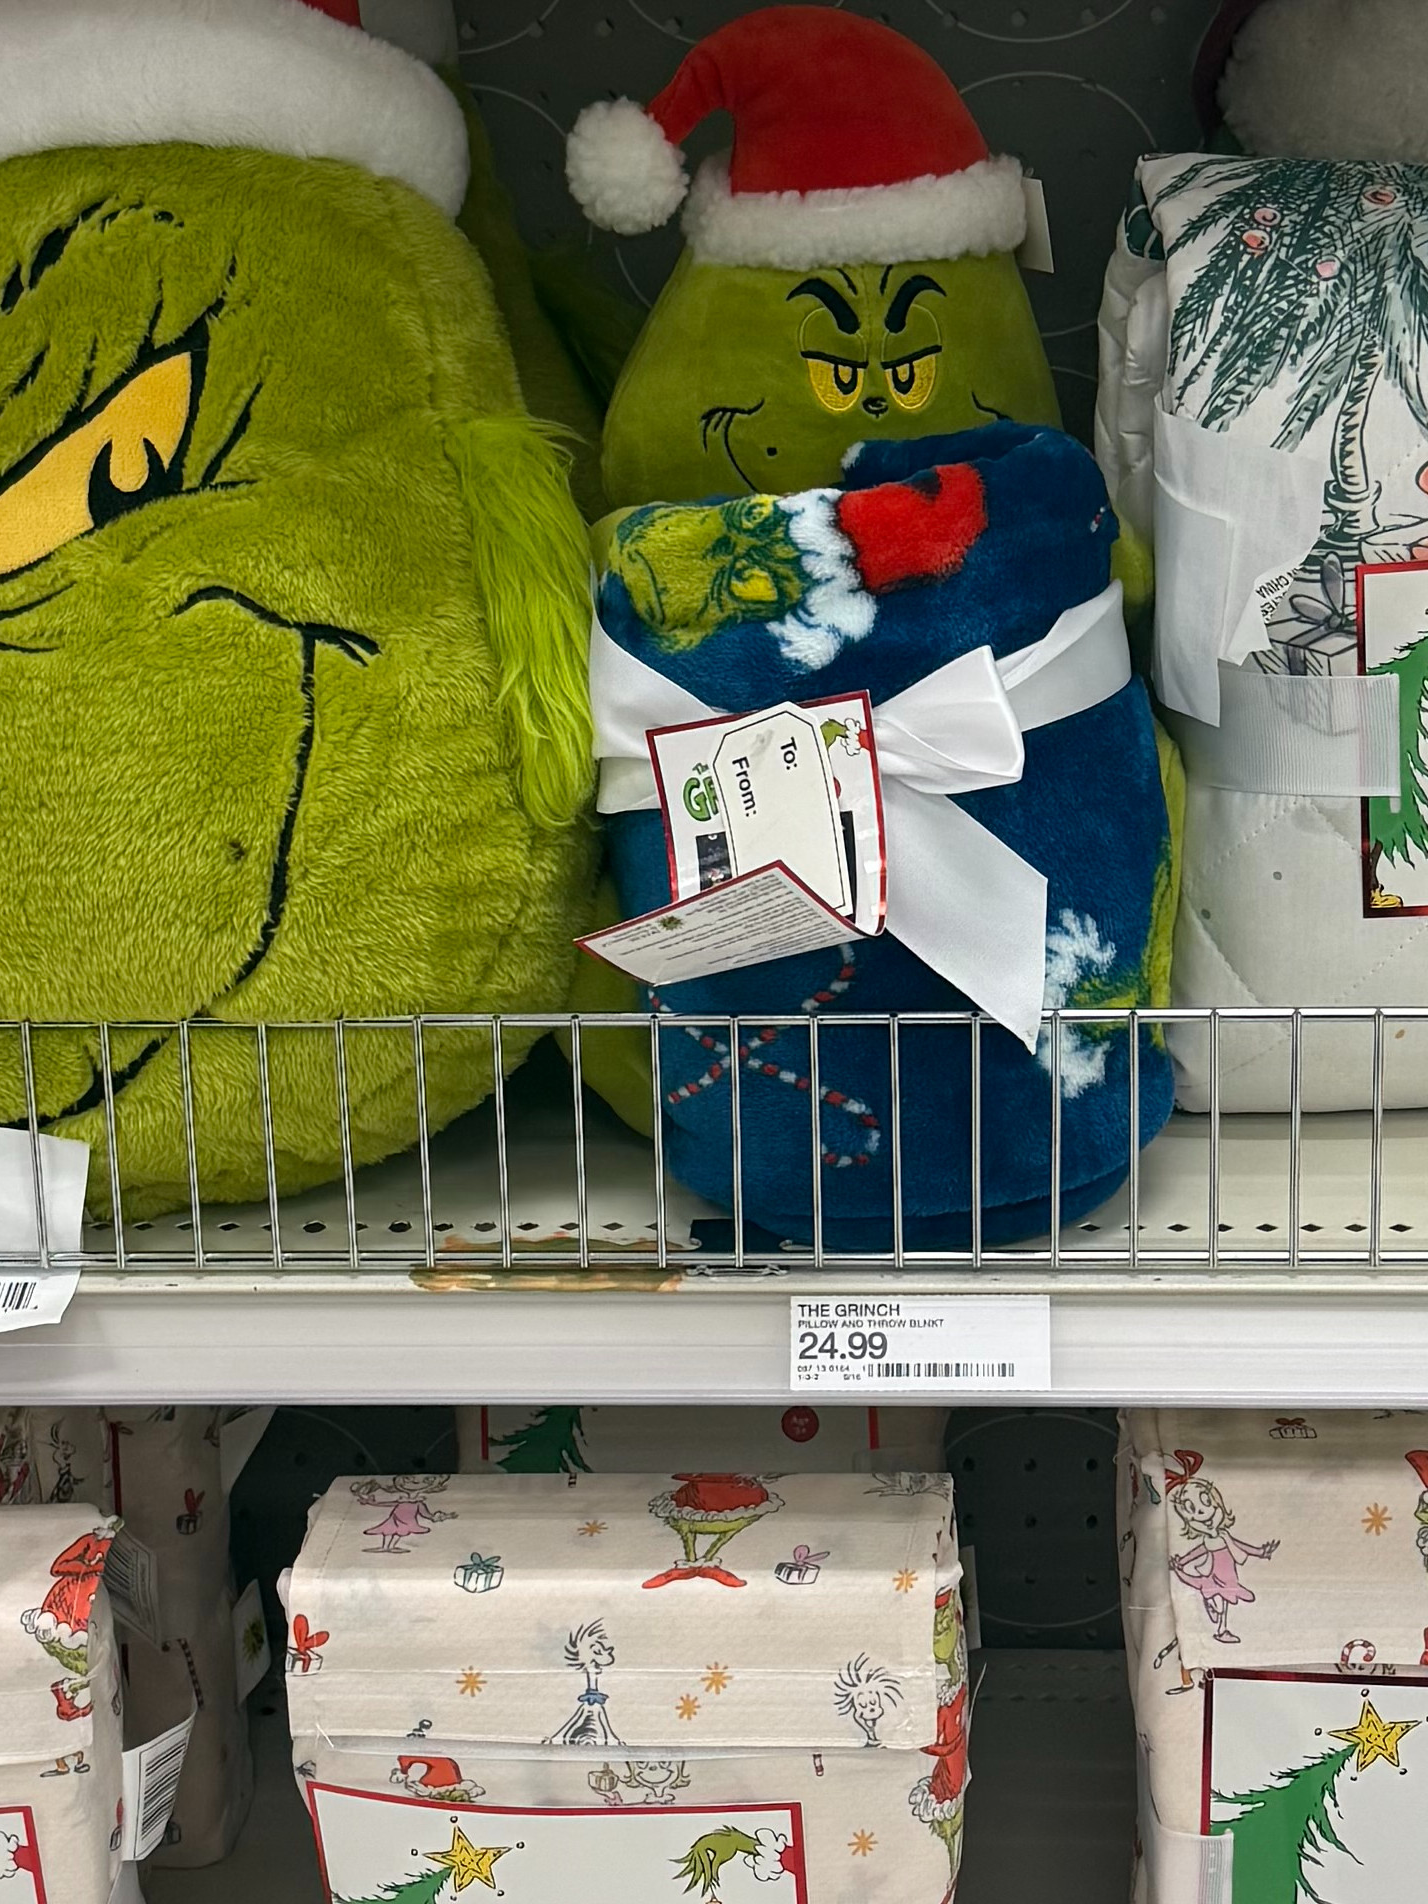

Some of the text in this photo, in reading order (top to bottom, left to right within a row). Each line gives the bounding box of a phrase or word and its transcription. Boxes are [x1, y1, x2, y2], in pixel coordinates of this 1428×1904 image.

[780, 736, 797, 770] To:
[732, 755, 758, 818] From:
[798, 1304, 900, 1317] THE GRINCH
[798, 1320, 839, 1328] PILLOW
[841, 1320, 863, 1328] AND
[867, 1319, 906, 1328] THROW
[798, 1332, 888, 1360] 24.99
